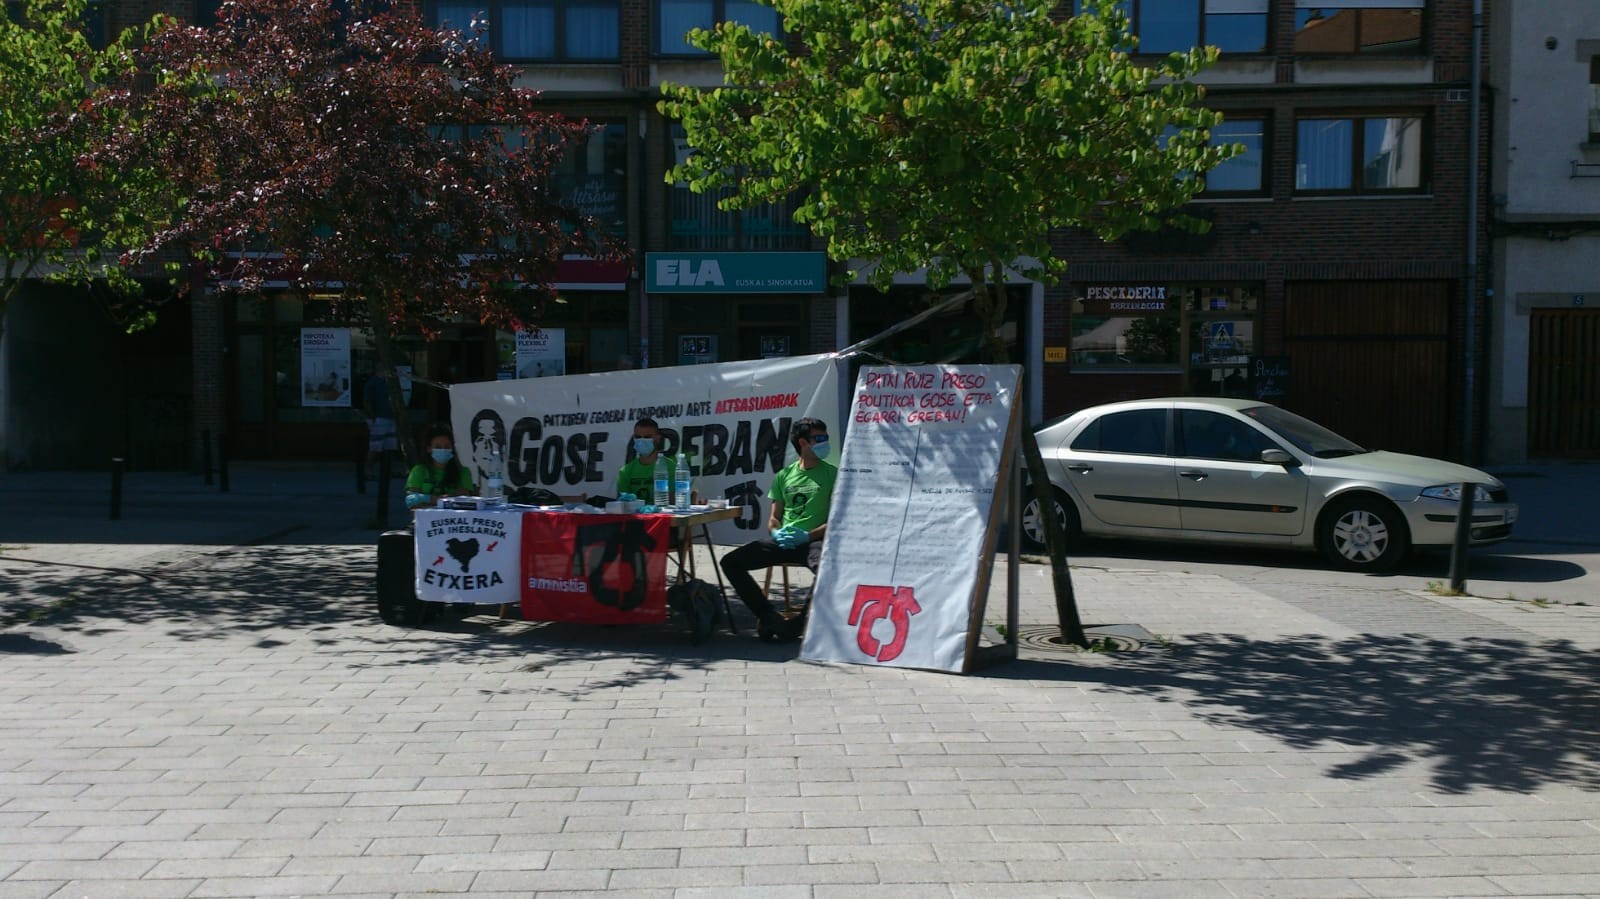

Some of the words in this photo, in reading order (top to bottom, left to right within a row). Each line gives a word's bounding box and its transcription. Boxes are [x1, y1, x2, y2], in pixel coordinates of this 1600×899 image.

[656, 259, 725, 286] ELA
[1087, 286, 1166, 300] PESCADERIA
[904, 371, 935, 389] RUIZ
[941, 372, 986, 389] PRESO
[857, 393, 915, 409] POLITIKOA
[920, 393, 957, 408] GOSE
[964, 393, 993, 407] ETA
[543, 412, 588, 428] PATXIREN
[589, 408, 626, 425] EGOERA
[686, 401, 711, 416] ARTE
[715, 392, 800, 414] ALTSASUARRAK
[855, 411, 900, 424] EGARRI
[907, 409, 967, 424] GREBAN!
[508, 417, 609, 486] GOSE
[431, 518, 469, 528] EUSKAL
[472, 517, 505, 530] PRESO
[427, 528, 445, 538] ETA
[448, 526, 507, 539] IHESLARIAK
[423, 568, 504, 590] ETXERA
[528, 577, 588, 593] amnistia
